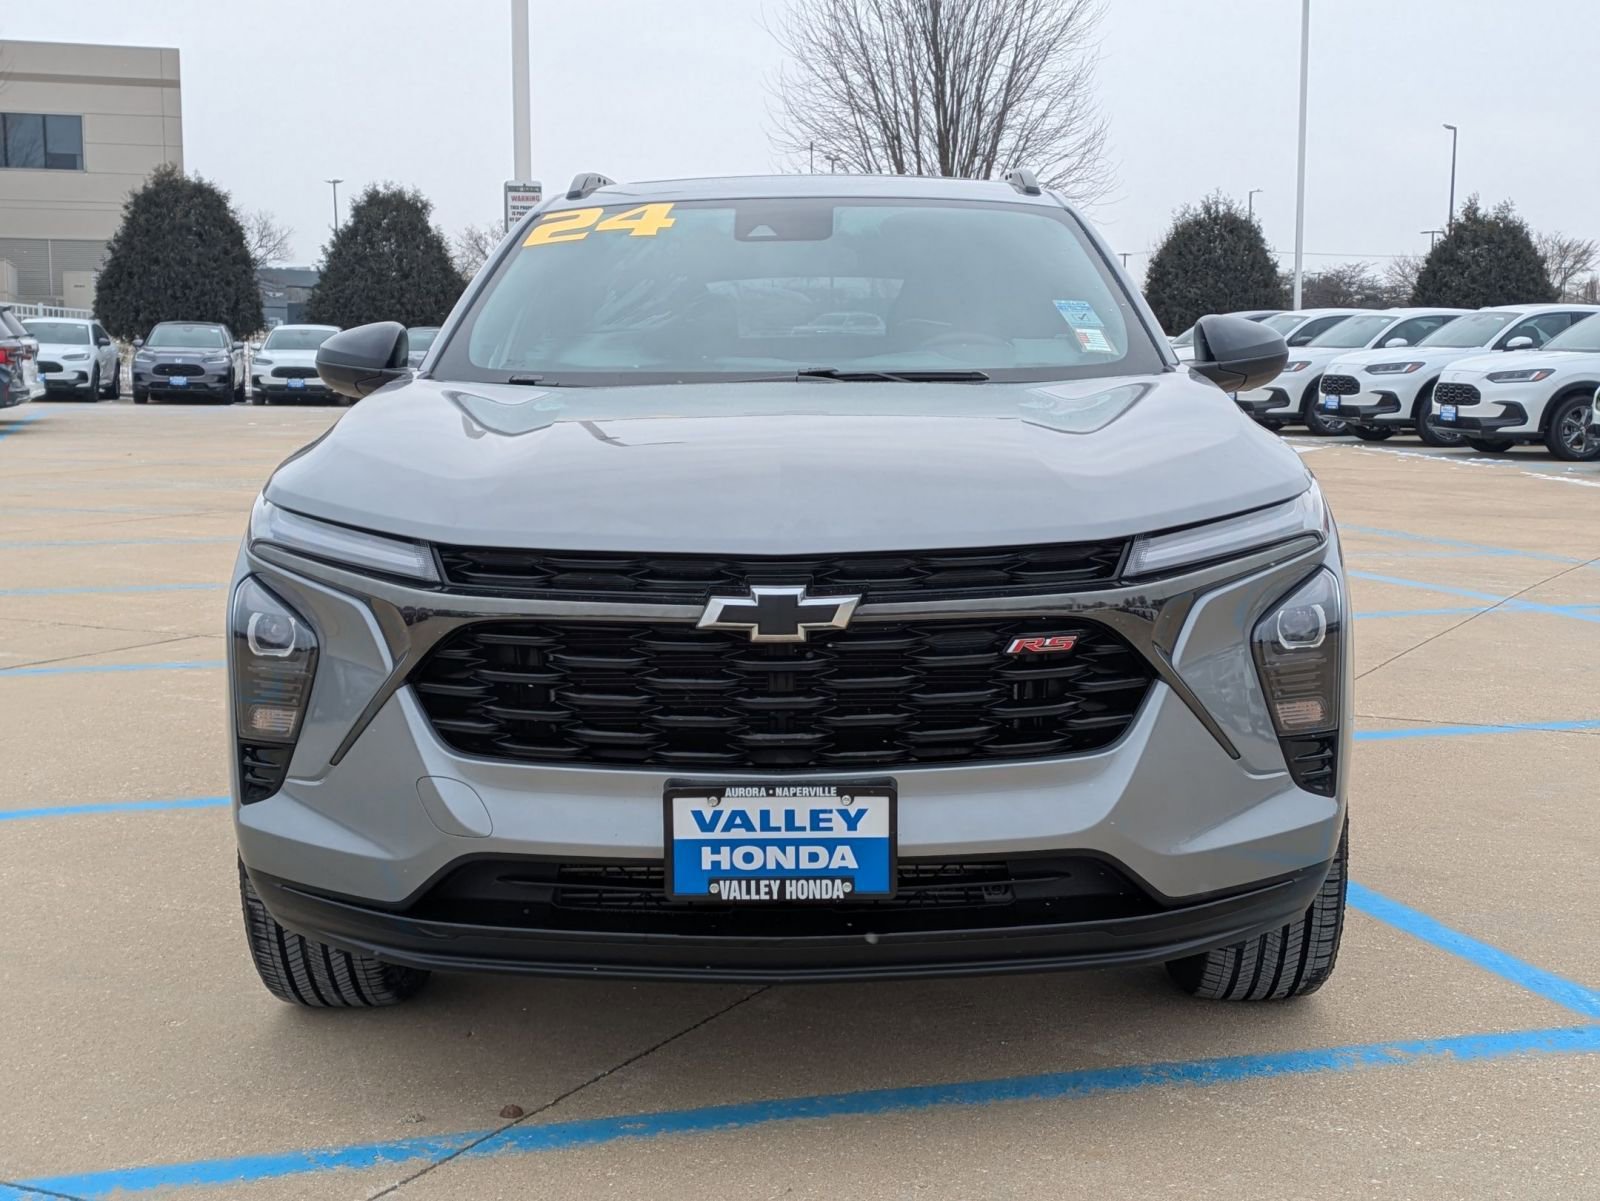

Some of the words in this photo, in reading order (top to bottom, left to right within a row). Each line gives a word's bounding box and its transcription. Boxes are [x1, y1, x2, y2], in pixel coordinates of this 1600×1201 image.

[522, 202, 677, 247] 24
[1006, 635, 1078, 653] RS
[725, 787, 766, 797] AURORA
[775, 786, 837, 797] NAPERVILLE
[690, 808, 869, 833] VALLEY
[701, 845, 859, 870] HONDA
[719, 880, 781, 900] VALLEY
[785, 879, 844, 900] HONDA
